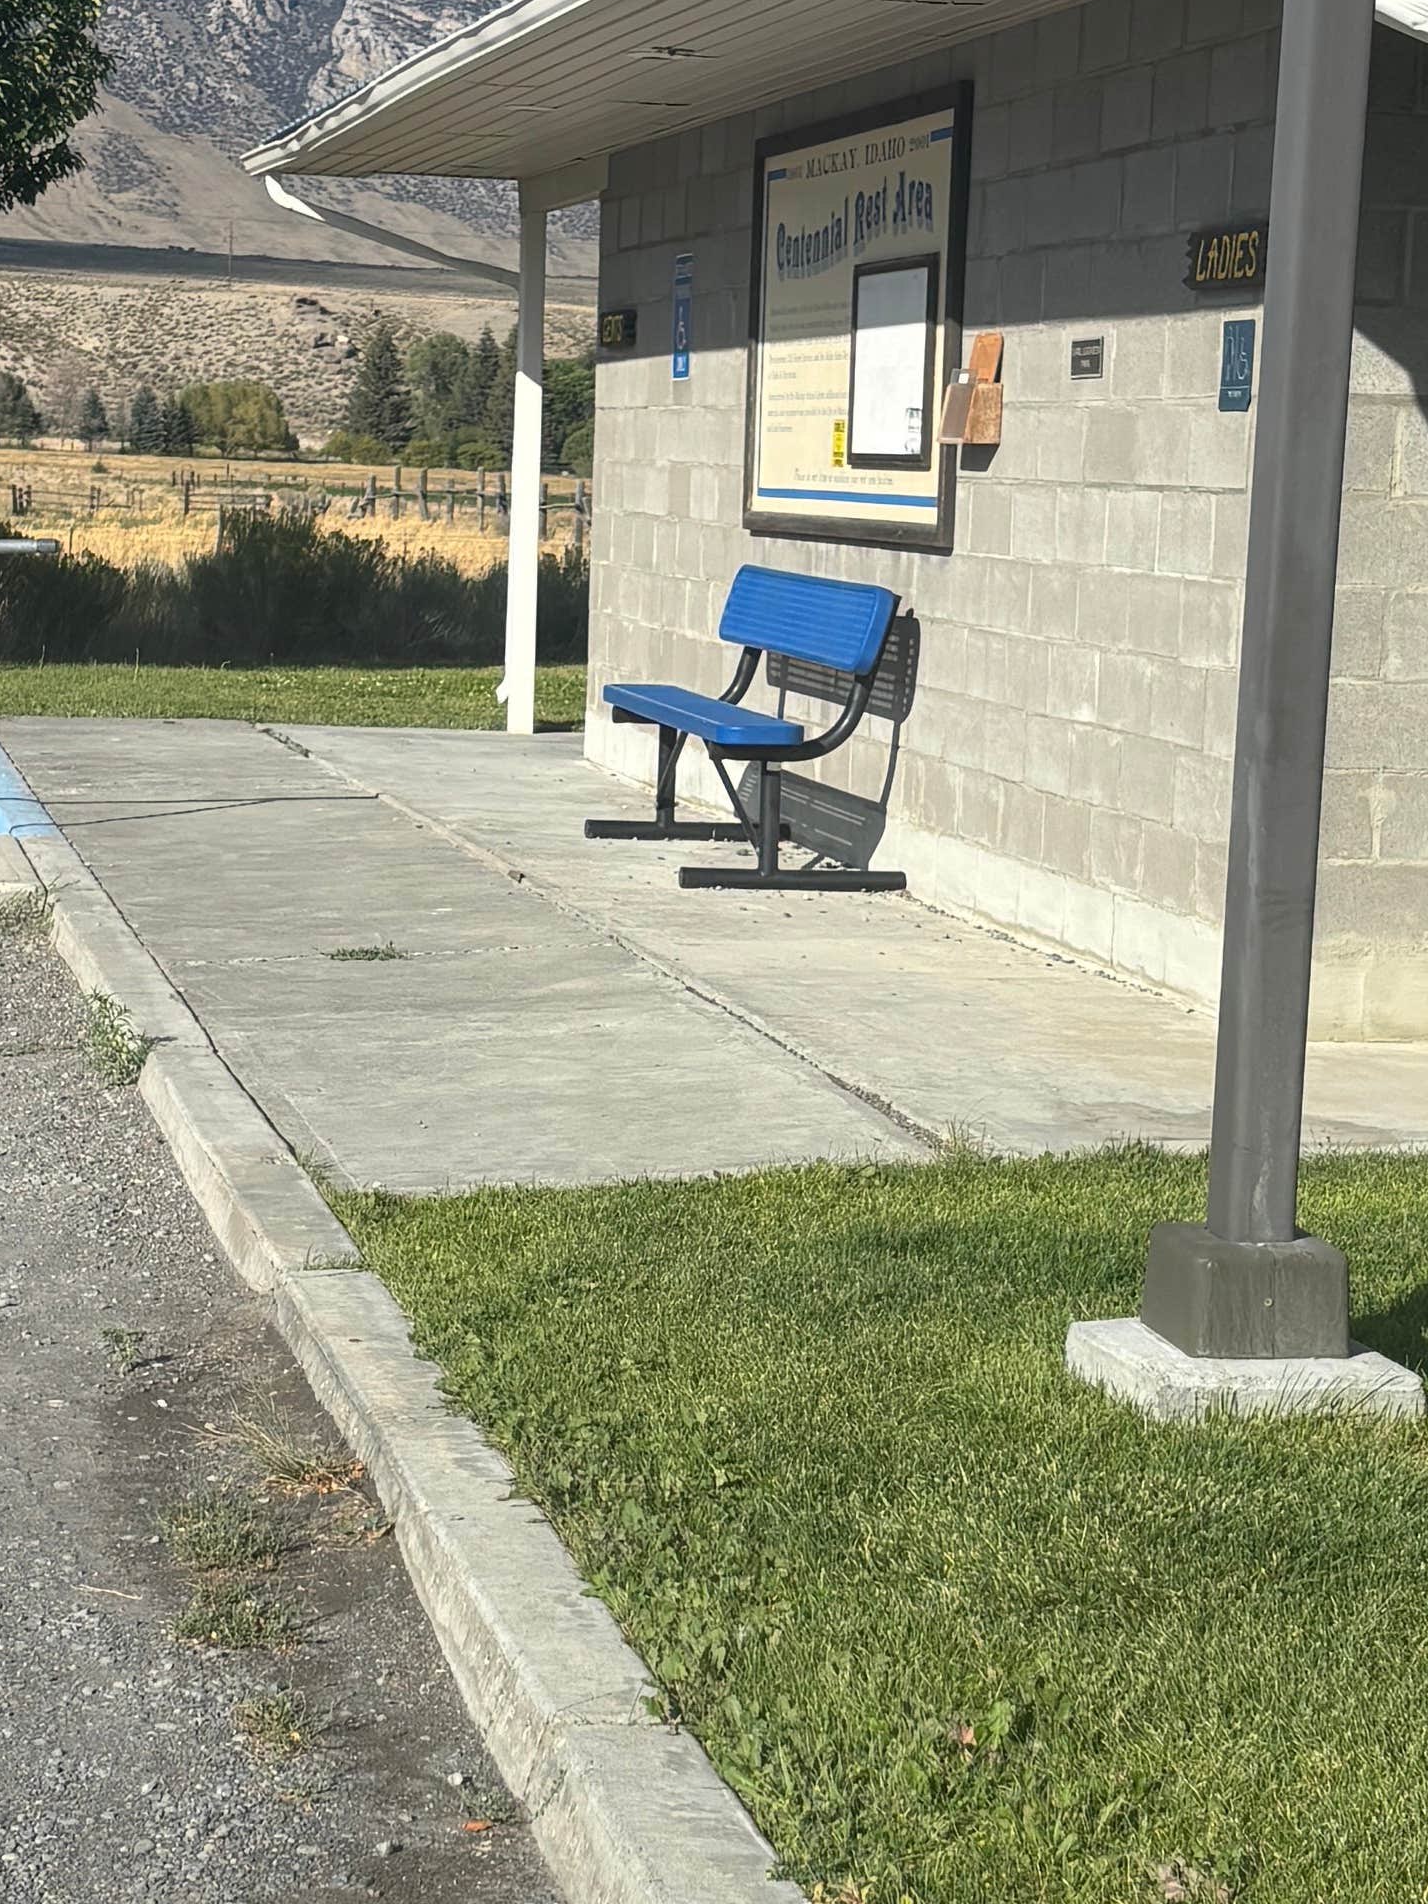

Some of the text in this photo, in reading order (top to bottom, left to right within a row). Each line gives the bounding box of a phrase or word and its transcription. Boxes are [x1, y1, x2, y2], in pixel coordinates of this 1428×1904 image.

[864, 135, 906, 165] IDAHO
[776, 170, 934, 273] Centennial Rest Area
[1195, 230, 1260, 281] LADIES
